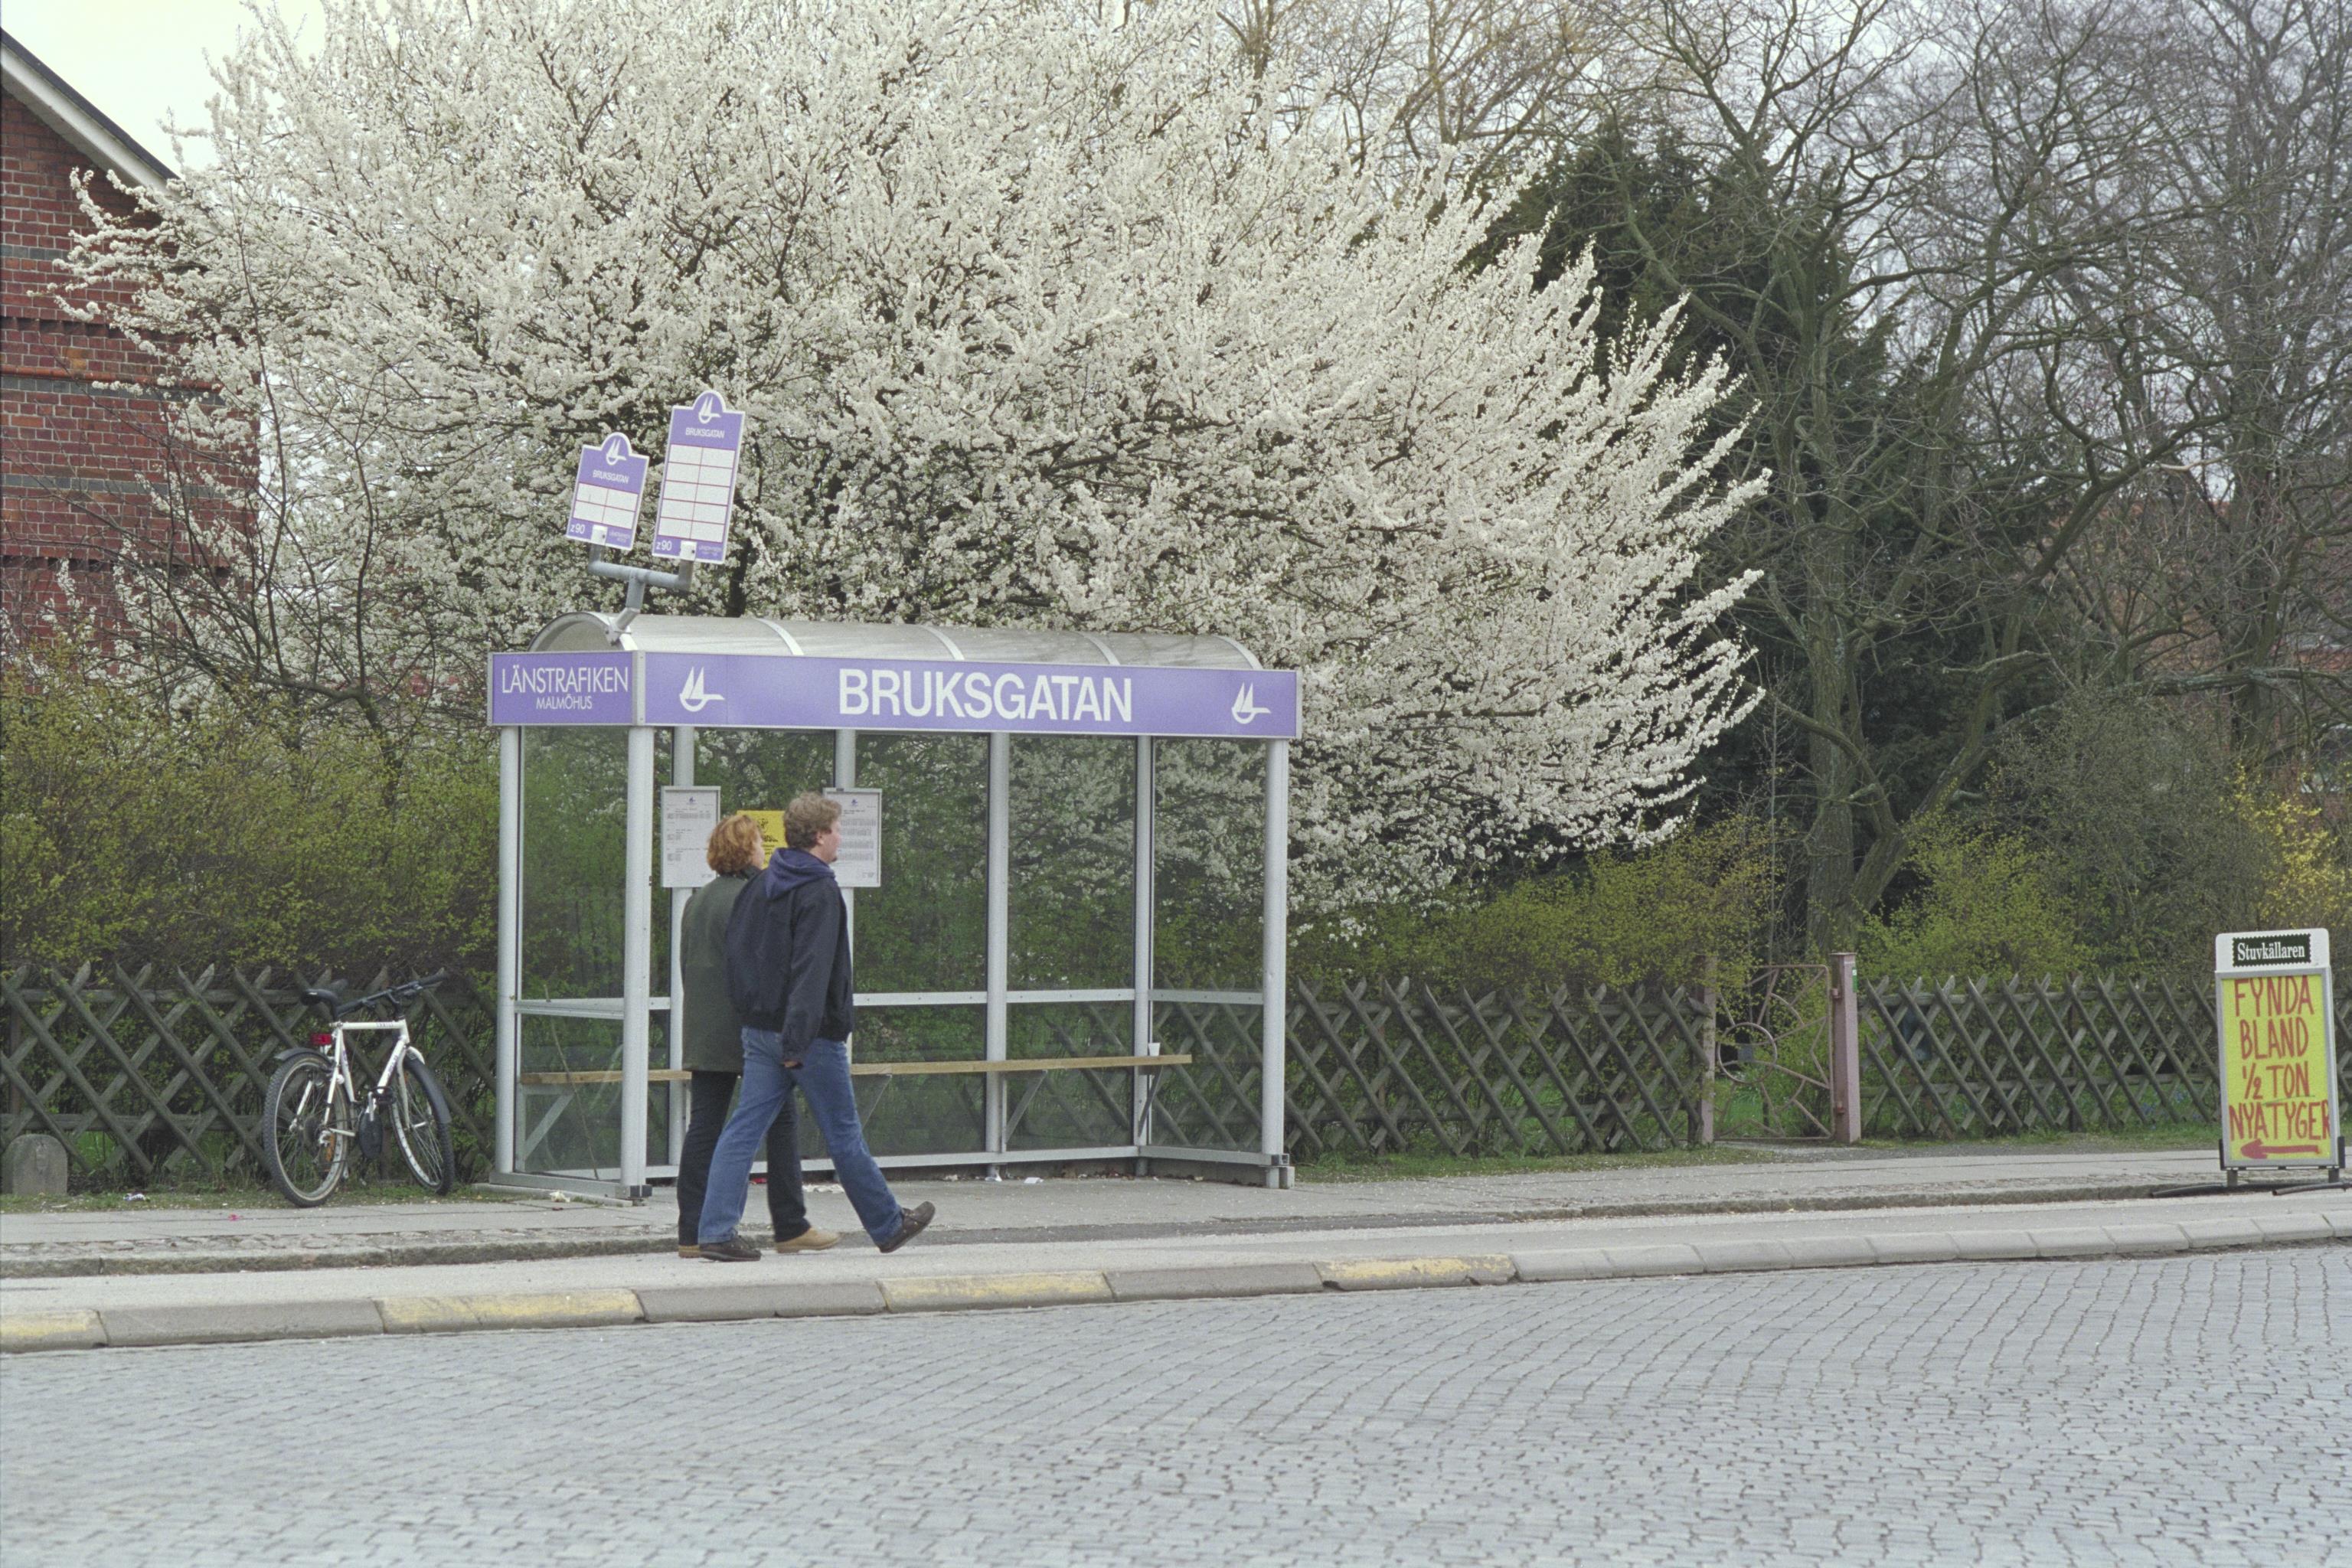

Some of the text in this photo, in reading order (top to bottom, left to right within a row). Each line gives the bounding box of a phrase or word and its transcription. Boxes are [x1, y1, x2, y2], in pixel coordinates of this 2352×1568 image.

[685, 427, 725, 439] BRUKSGATAN
[570, 523, 586, 534] z90
[656, 539, 672, 551] z90
[501, 665, 629, 693] LÄNSTRAFIKEN
[536, 695, 592, 710] MALMÖHUS
[840, 668, 1132, 722] BRUKSGATAN
[2237, 942, 2305, 961] Stuvkällaren
[2234, 975, 2314, 1018] FYNDA
[2239, 1017, 2309, 1060] BLAND
[2265, 1060, 2311, 1099] TON
